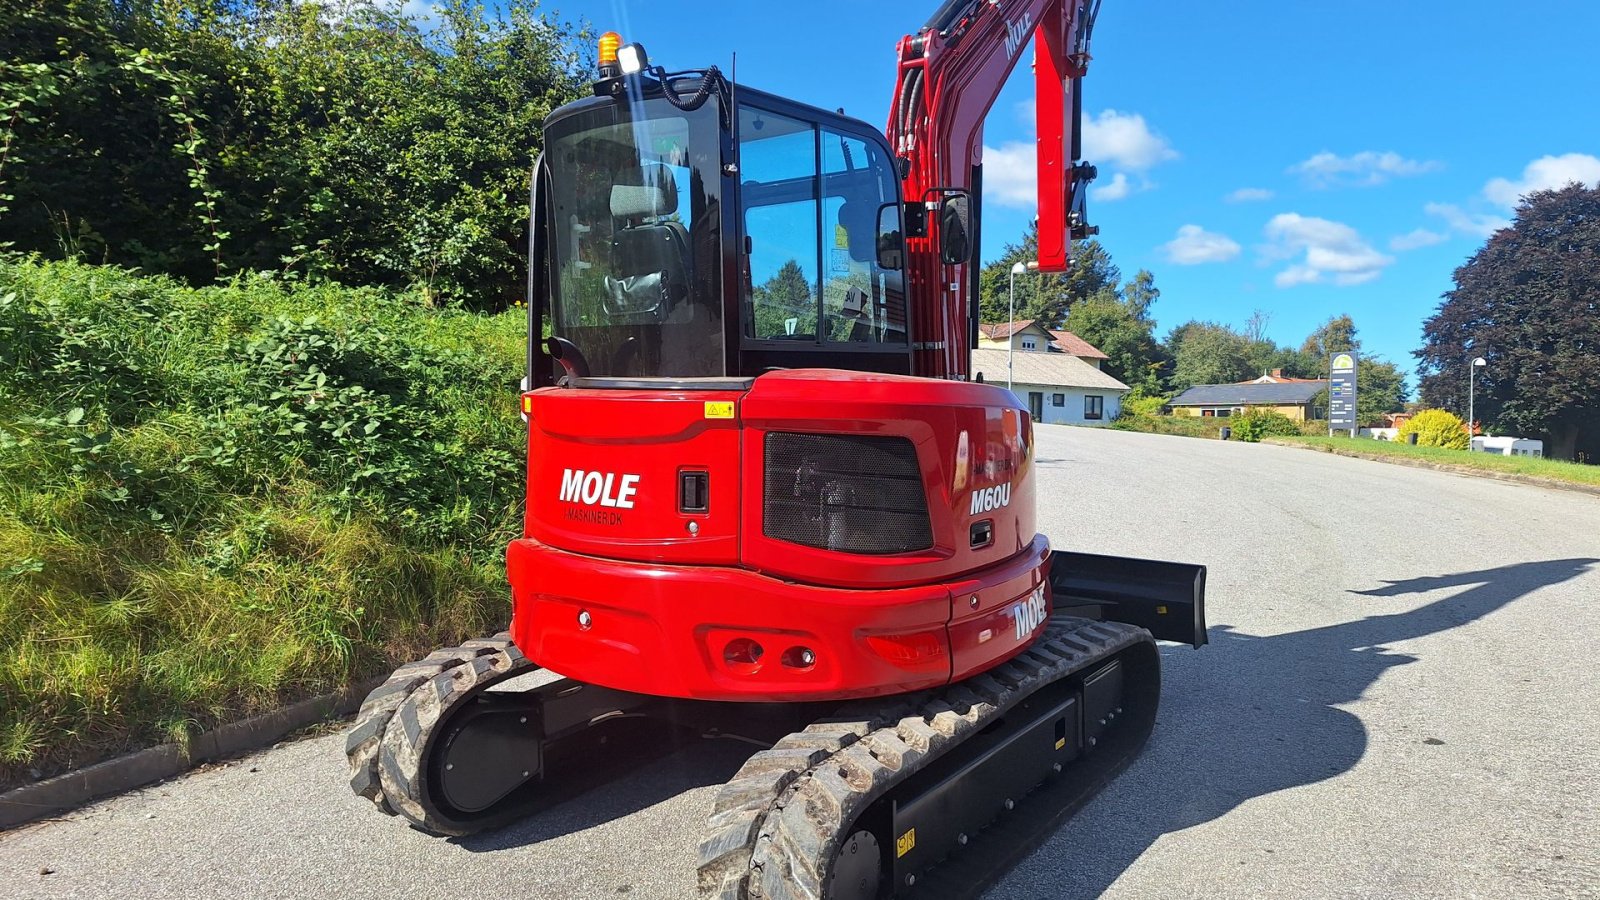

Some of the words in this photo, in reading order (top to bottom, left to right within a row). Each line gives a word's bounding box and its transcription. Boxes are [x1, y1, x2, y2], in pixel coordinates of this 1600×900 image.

[1003, 12, 1032, 61] MOLE
[559, 468, 641, 509] MOLE
[968, 481, 1011, 516] M60U
[1013, 579, 1048, 642] MOLE
